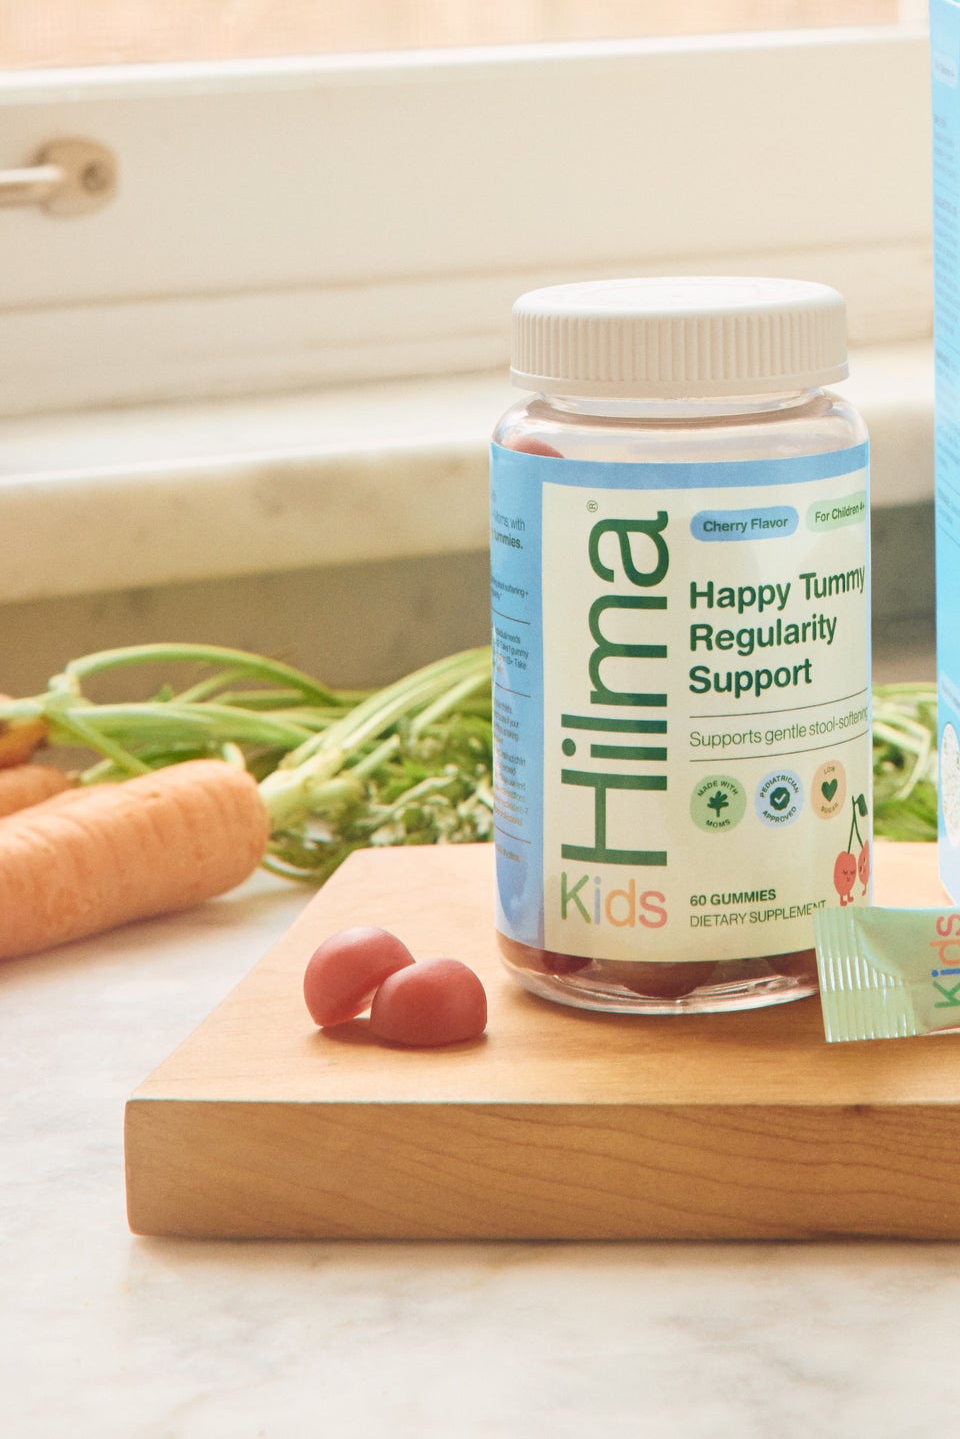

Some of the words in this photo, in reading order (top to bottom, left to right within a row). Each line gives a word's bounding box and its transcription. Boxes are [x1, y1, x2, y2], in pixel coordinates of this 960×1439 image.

[815, 511, 830, 523] For
[831, 504, 859, 520] Children
[703, 520, 747, 533] Cherry
[750, 517, 788, 530] Flavor
[690, 580, 791, 615] Happy
[799, 565, 865, 601] Tummy
[690, 613, 838, 657] Regularity
[561, 510, 669, 867] Hilma
[689, 658, 813, 699] Support
[689, 729, 762, 749] Supports
[765, 723, 807, 745] gentle
[697, 779, 718, 797] MADE
[720, 779, 739, 796] WITH
[760, 774, 799, 799] PEDIATRICIAN
[705, 818, 731, 828] MOMS
[762, 805, 797, 824] APPROVED
[560, 871, 668, 929] Kids
[689, 894, 707, 907] 60
[710, 888, 777, 905] GUMMIES
[689, 913, 747, 928] DIETARY
